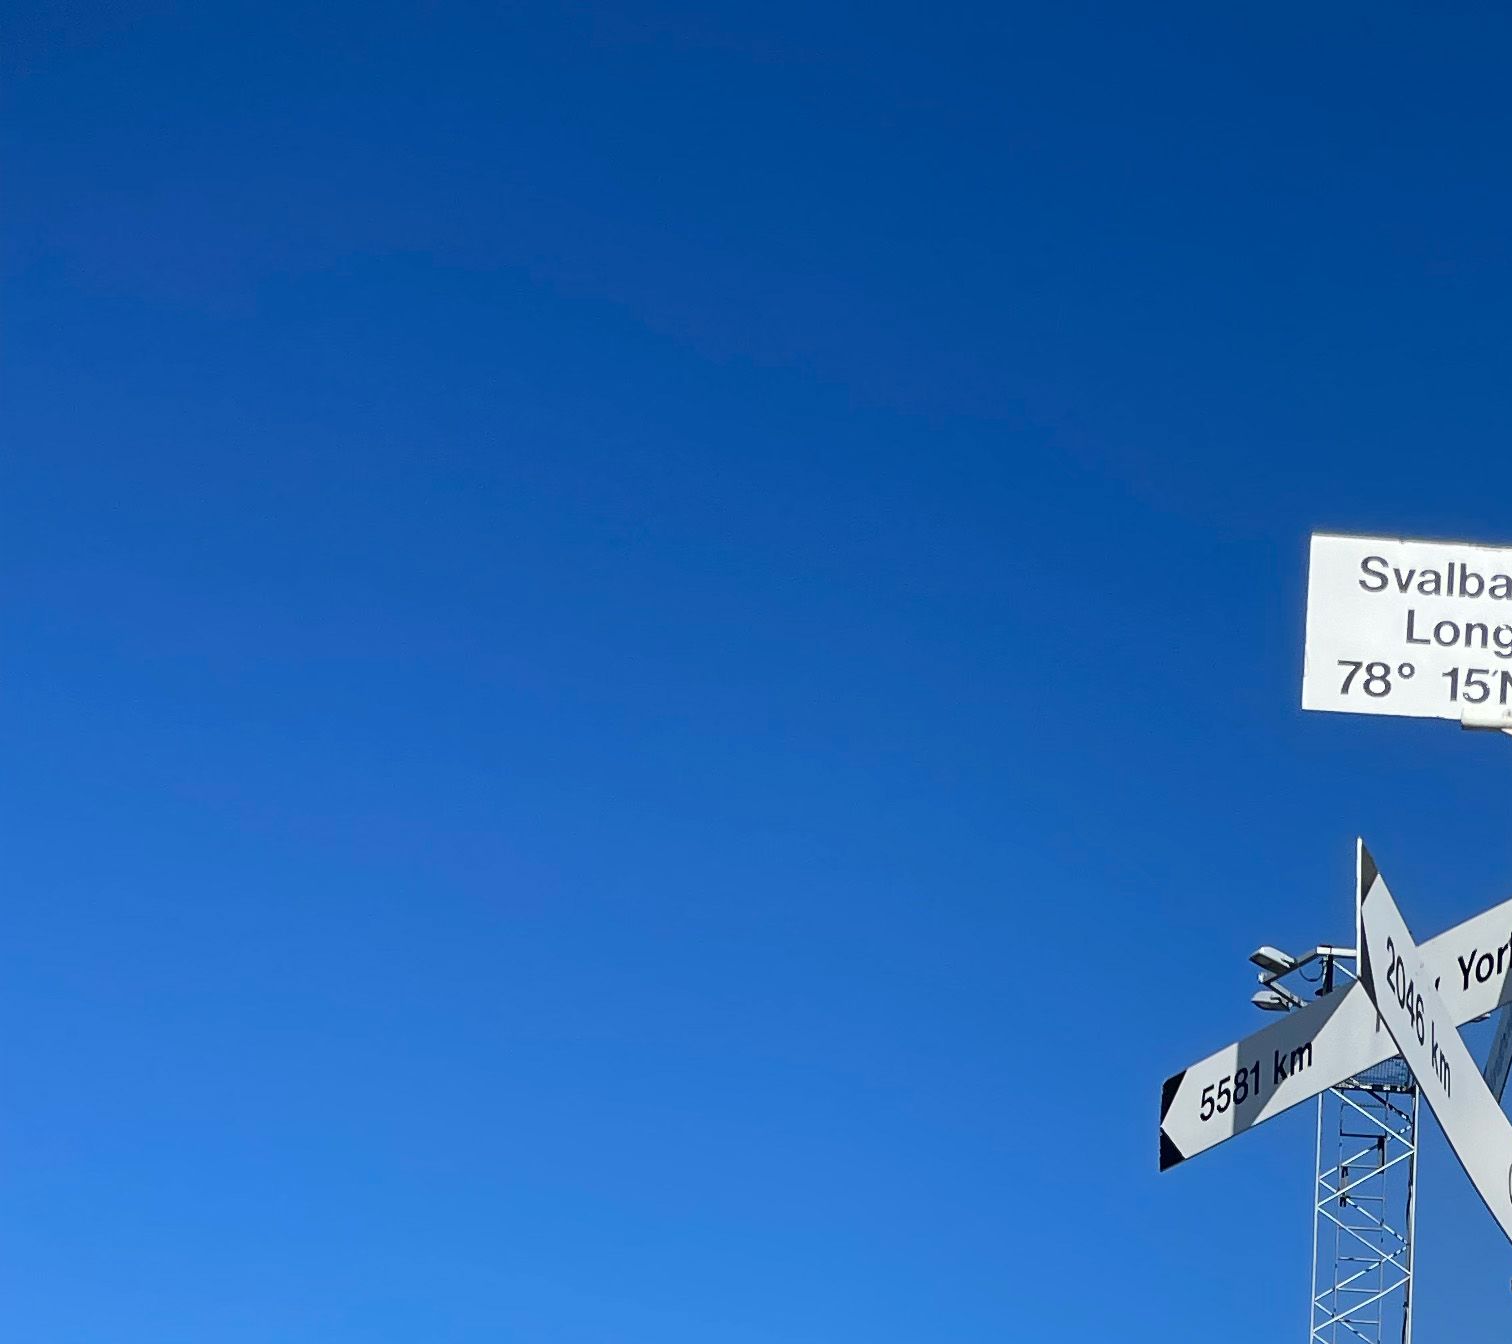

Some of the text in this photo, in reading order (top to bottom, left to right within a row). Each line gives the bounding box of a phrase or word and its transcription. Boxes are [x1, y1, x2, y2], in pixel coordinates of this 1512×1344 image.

[1336, 658, 1416, 698] 78°
[1386, 935, 1426, 1047] 2046
[1430, 1020, 1452, 1099] km
[1199, 1067, 1261, 1123] 5581
[1273, 1039, 1313, 1086] km
